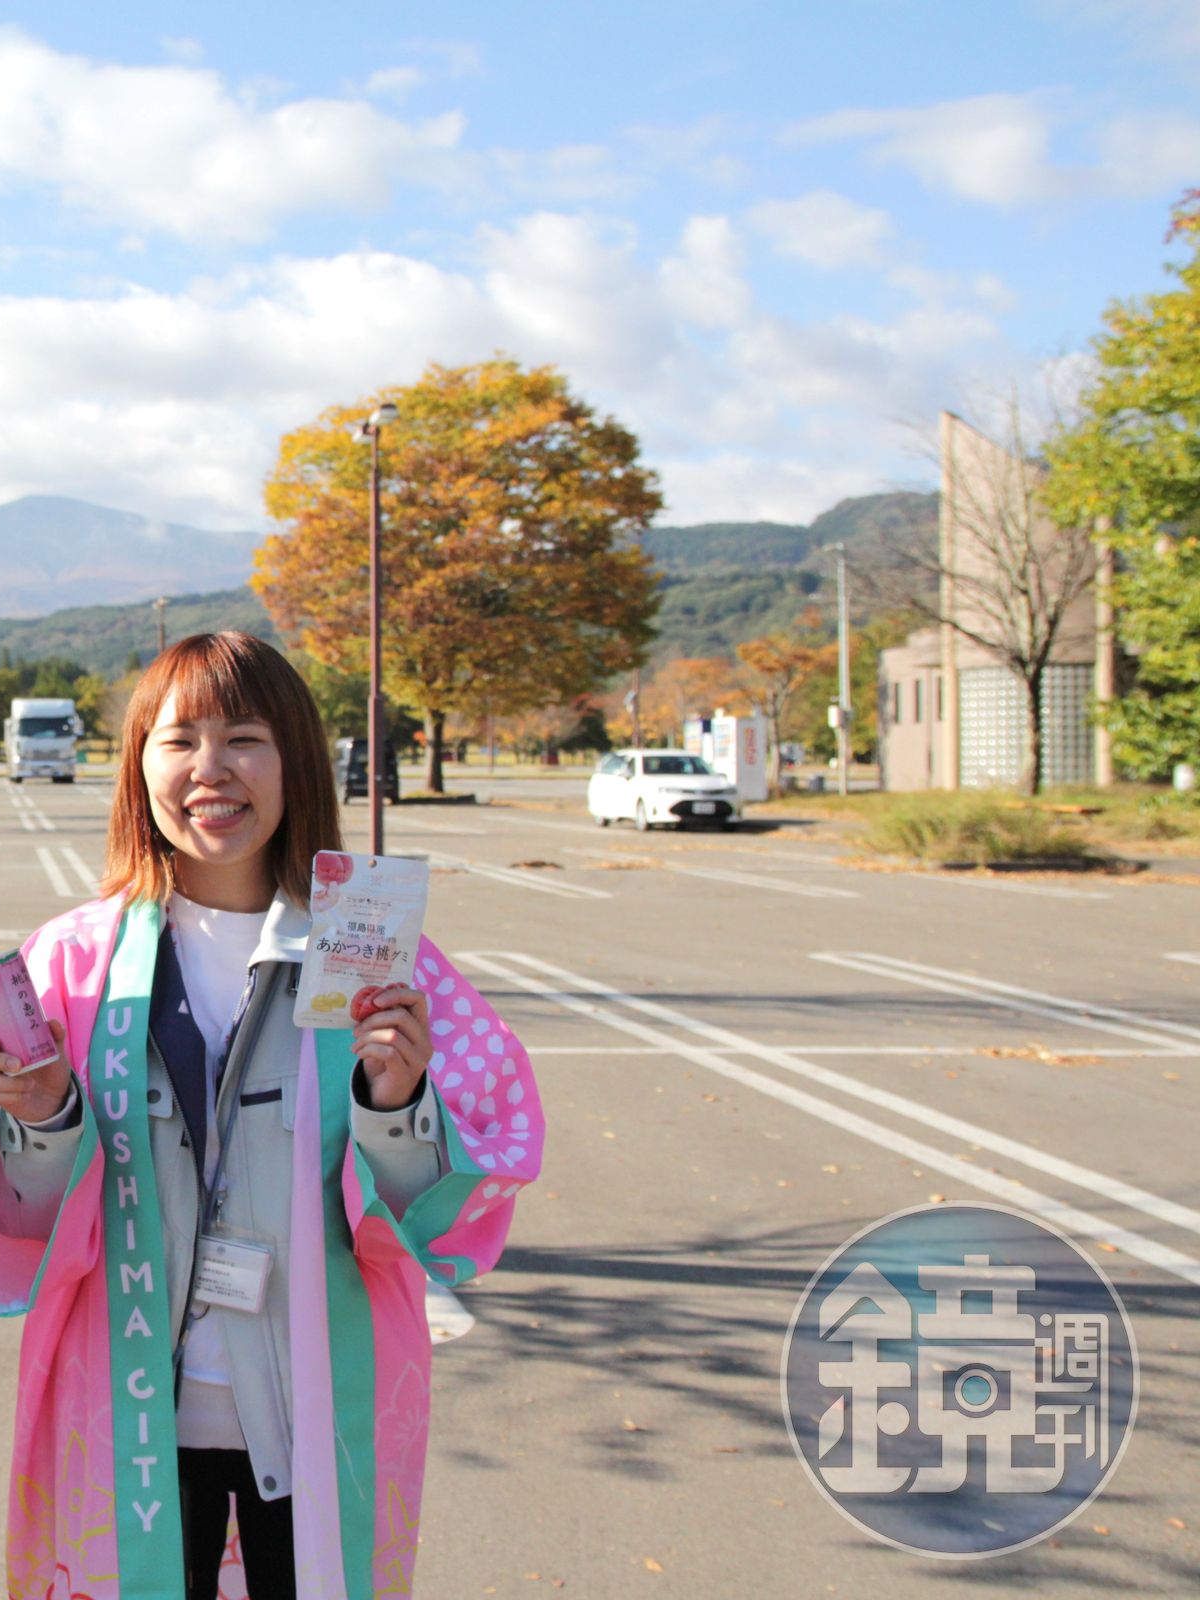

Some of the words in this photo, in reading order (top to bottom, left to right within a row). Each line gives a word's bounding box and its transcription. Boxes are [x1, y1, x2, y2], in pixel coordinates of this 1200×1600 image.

[316, 937, 409, 963] あかつき桃グミ
[127, 1368, 162, 1532] CITY
